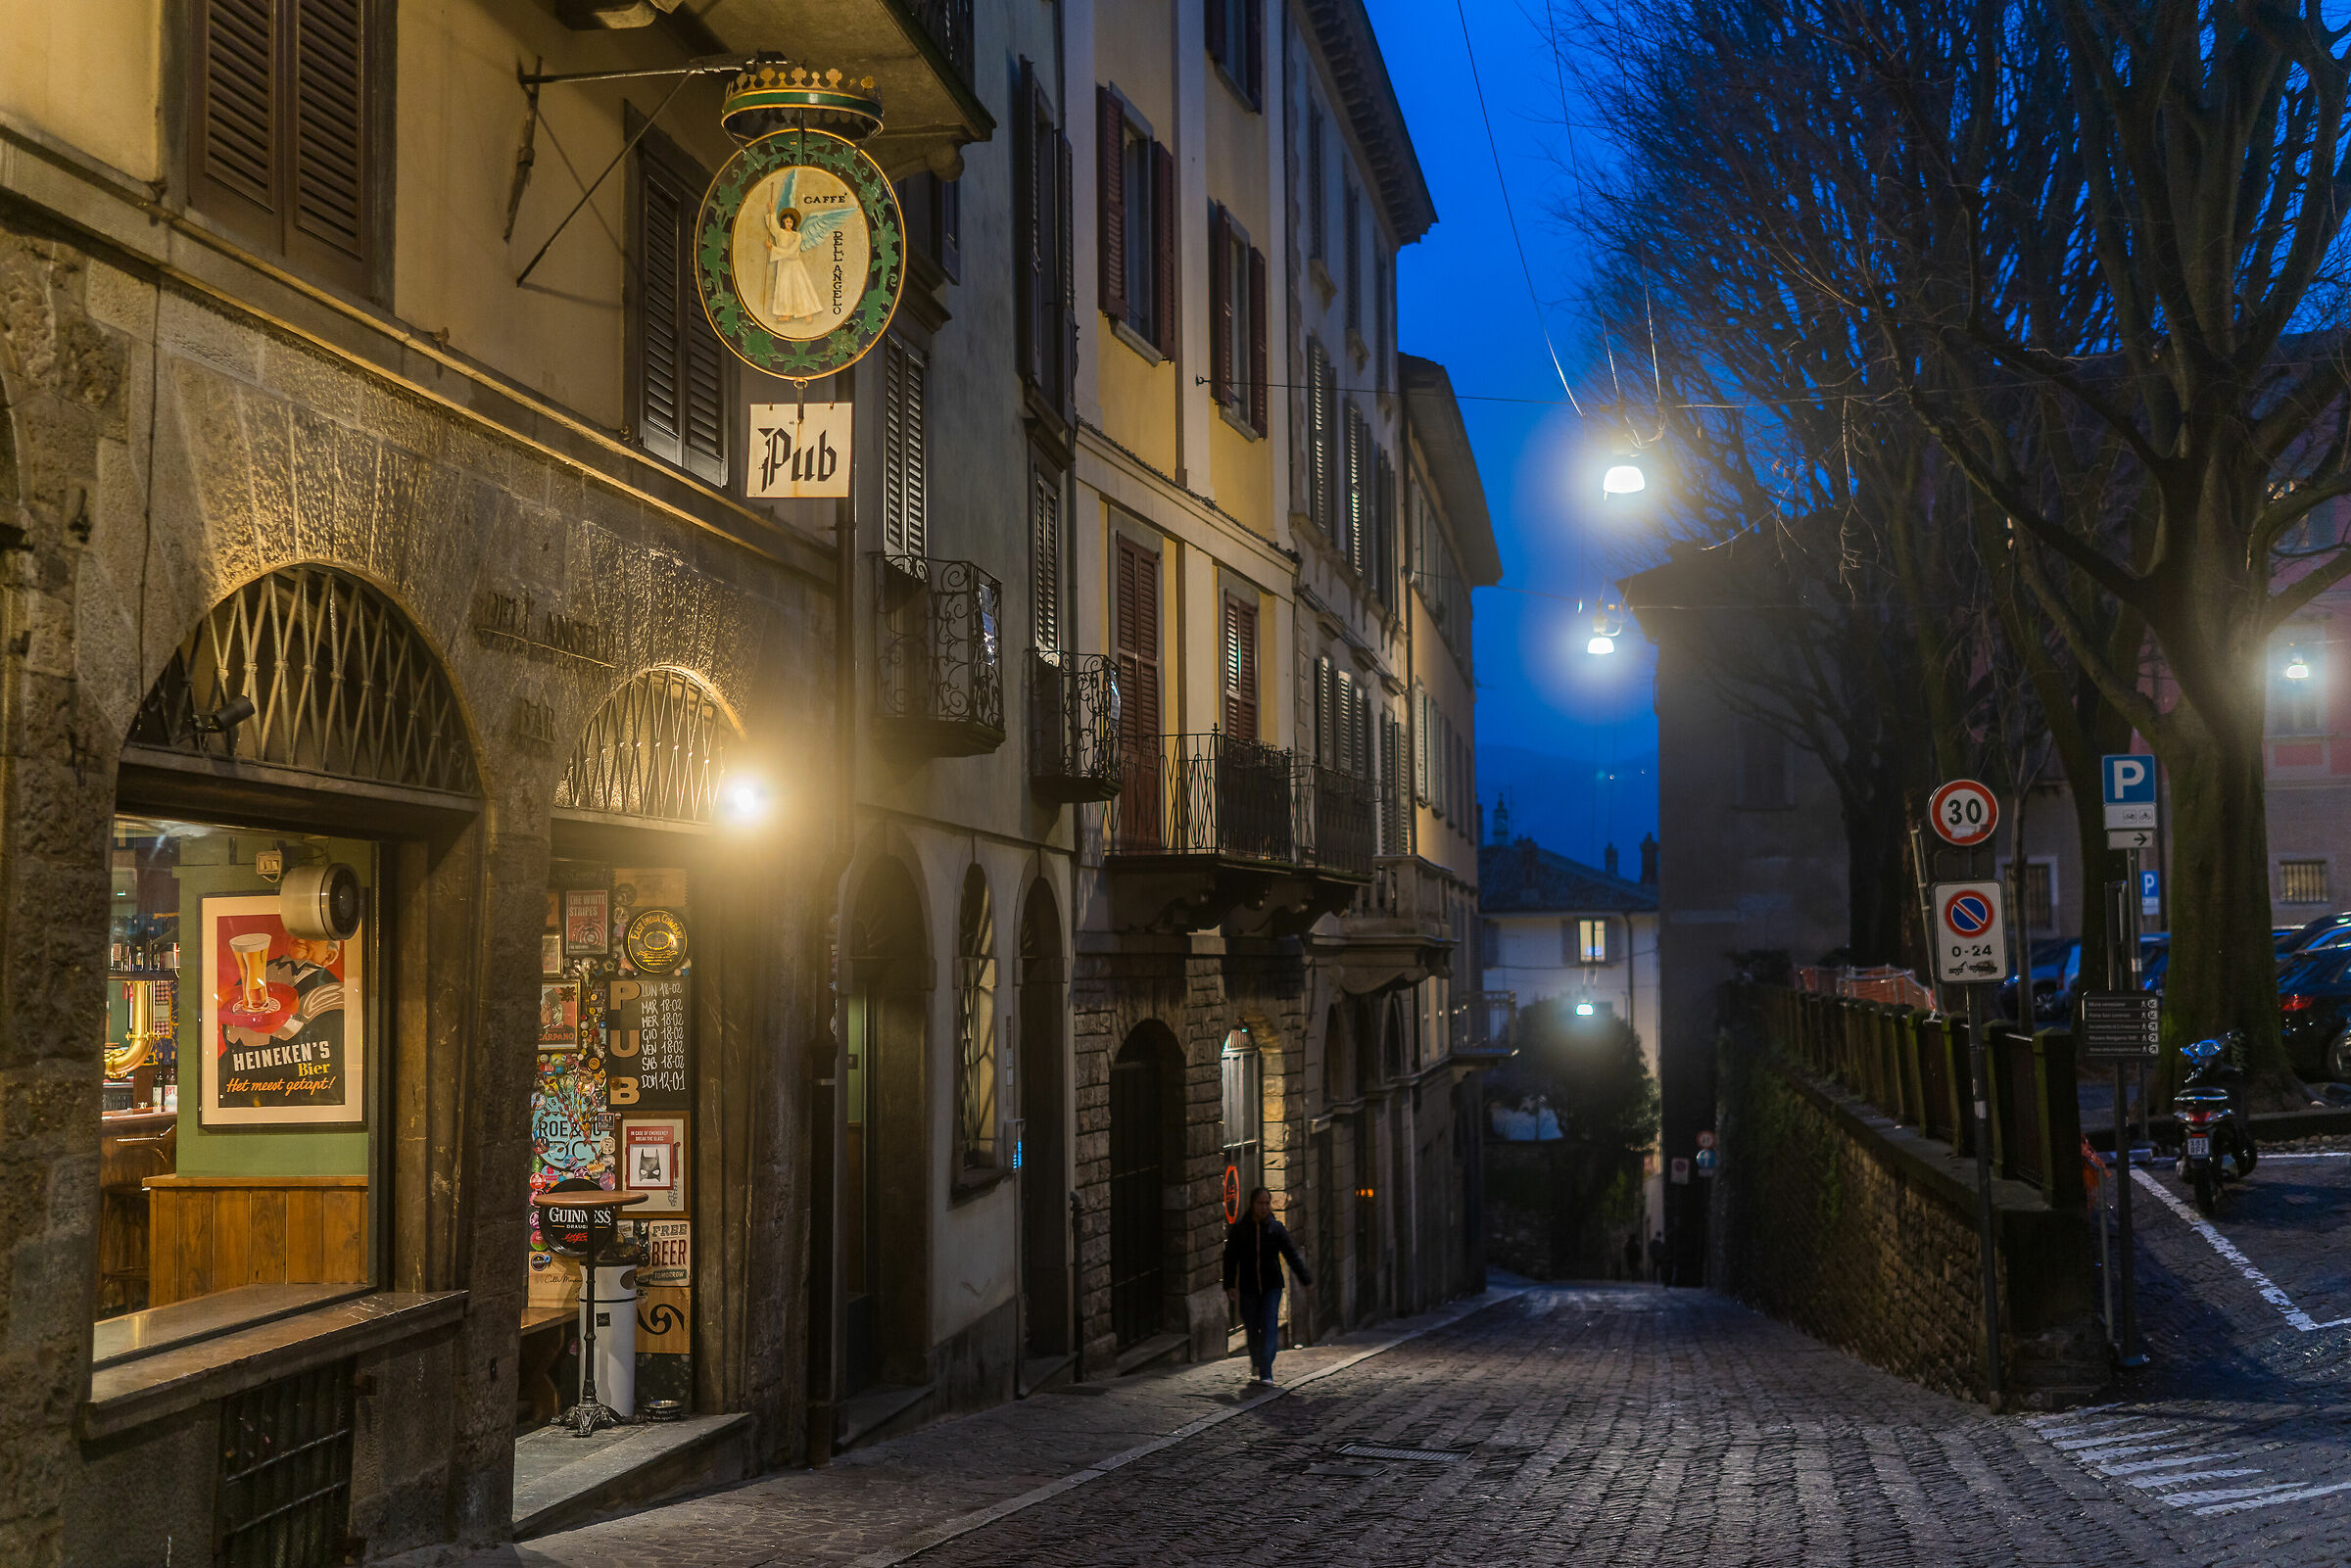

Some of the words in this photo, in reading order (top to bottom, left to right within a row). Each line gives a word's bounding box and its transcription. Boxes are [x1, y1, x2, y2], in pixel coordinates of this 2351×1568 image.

[832, 264, 842, 314] ANGELO
[757, 428, 838, 493] Pub
[2113, 760, 2145, 799] P
[1947, 798, 1982, 825] 30
[2144, 874, 2154, 894] P
[570, 894, 582, 905] THE
[583, 894, 605, 905] WHITE
[569, 906, 598, 917] STRIPES
[642, 983, 657, 997] LUN
[659, 982, 682, 997] 18-02
[641, 999, 658, 1015] MAR
[660, 998, 683, 1013] 18-02
[642, 1015, 659, 1028] MER
[660, 1012, 684, 1026] 18-02
[642, 1028, 657, 1044] GIO
[660, 1026, 684, 1041] 18-02
[233, 1040, 330, 1071] HEINEKEN'S
[642, 1041, 657, 1056] VEN
[661, 1040, 684, 1054] 18-02
[297, 1063, 331, 1077] Bier
[642, 1057, 657, 1071] SAB
[661, 1055, 685, 1069] 18-02
[226, 1077, 250, 1093] Het
[251, 1077, 286, 1092] meest
[285, 1075, 337, 1097] getapt!
[641, 1071, 658, 1090] DOM
[658, 1070, 686, 1092] 12-01
[651, 1224, 688, 1237] FREE
[651, 1239, 687, 1266] BEER
